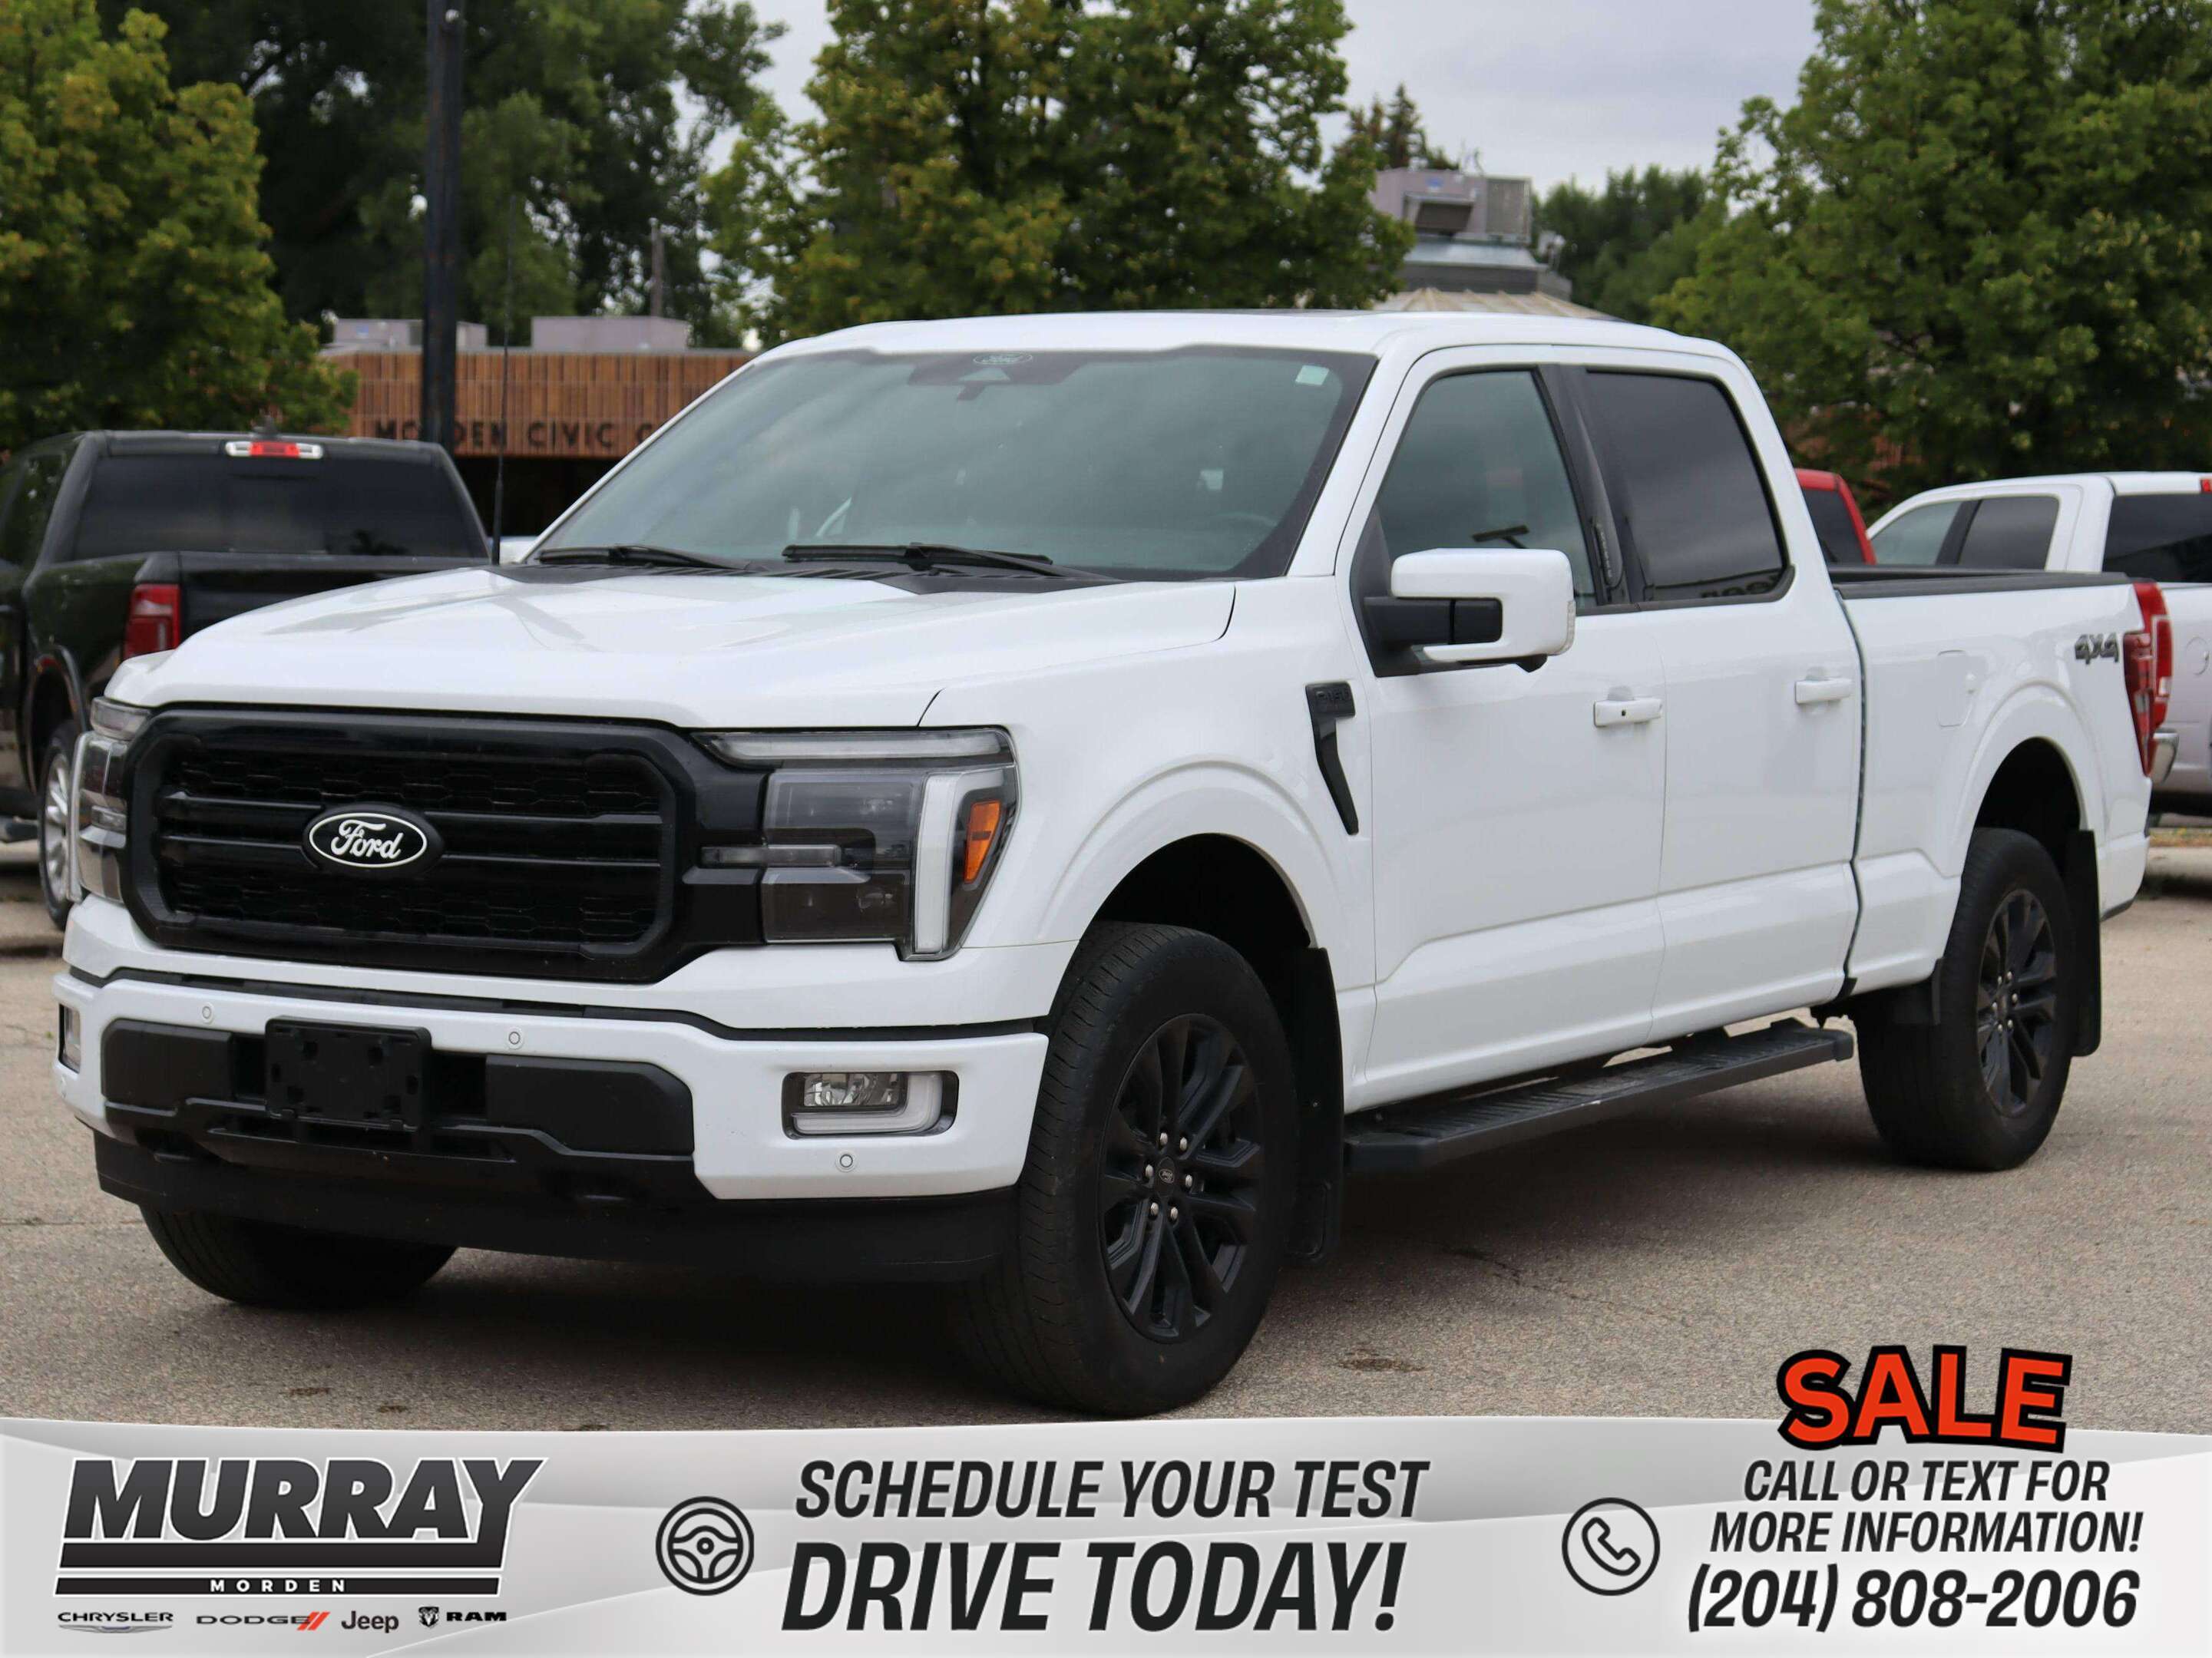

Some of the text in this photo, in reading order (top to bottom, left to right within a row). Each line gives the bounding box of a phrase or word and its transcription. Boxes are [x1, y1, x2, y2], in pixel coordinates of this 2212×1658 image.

[375, 421, 505, 448] MODEN
[527, 421, 613, 448] CIVIC
[330, 819, 404, 859] Ford
